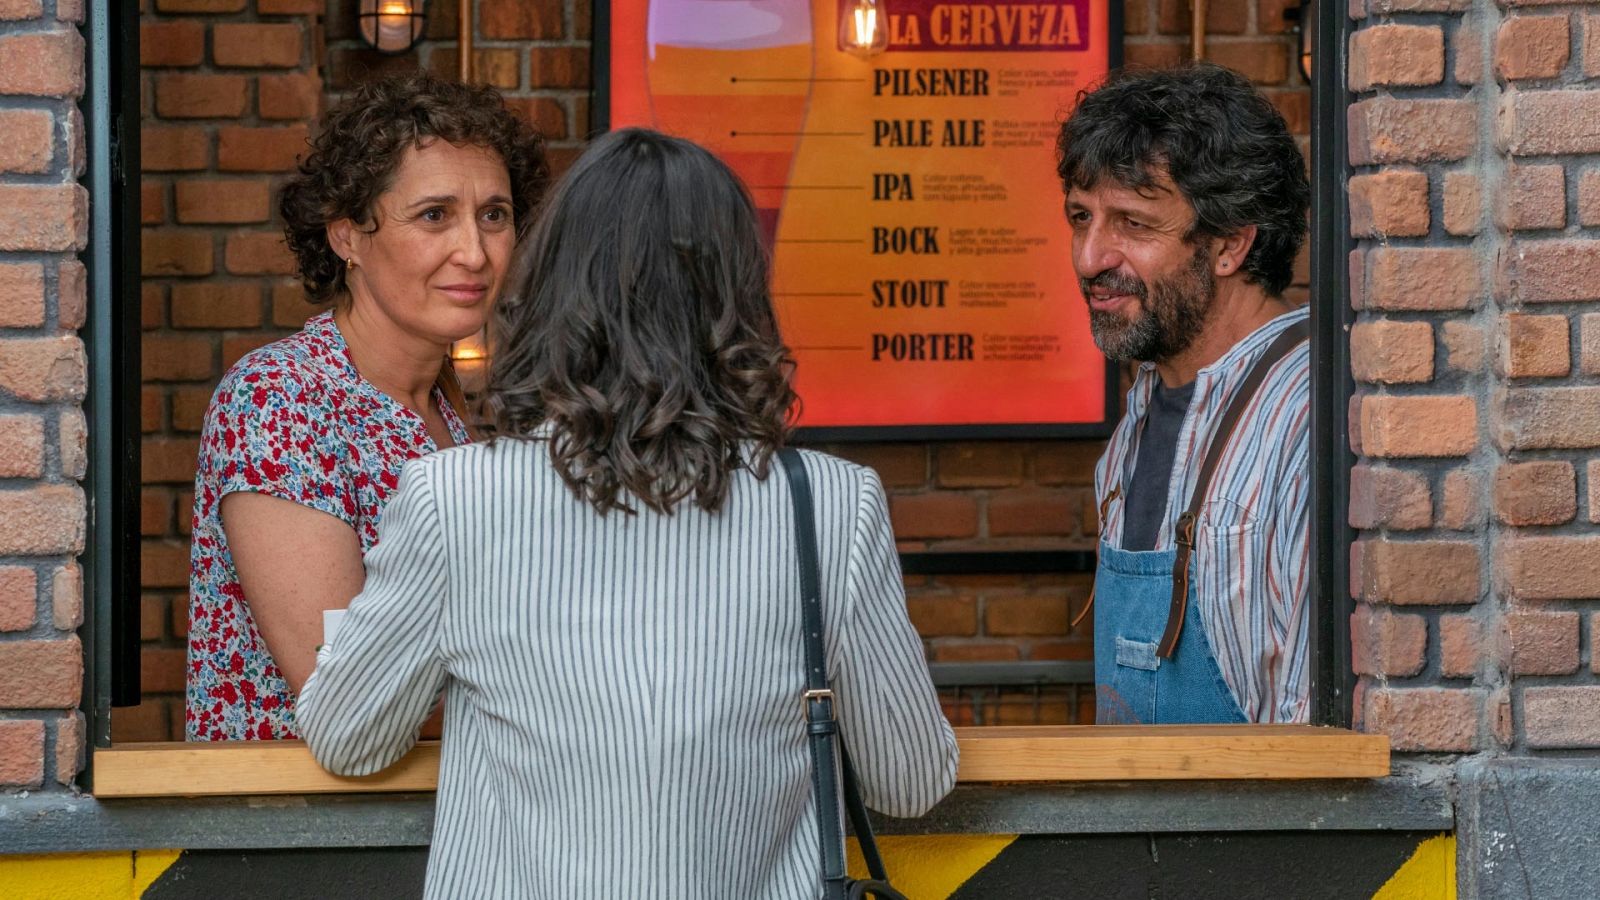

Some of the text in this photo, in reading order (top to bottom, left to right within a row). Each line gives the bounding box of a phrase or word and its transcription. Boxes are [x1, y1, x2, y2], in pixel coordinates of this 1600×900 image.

[890, 14, 921, 45] LA
[930, 4, 1080, 45] CERVEZA
[874, 69, 989, 96] PILSENER
[873, 120, 985, 147] PALE ALE
[873, 173, 914, 200] IPA
[872, 227, 939, 254] BOCK
[872, 280, 948, 307] STOUT
[872, 334, 974, 361] PORTER
